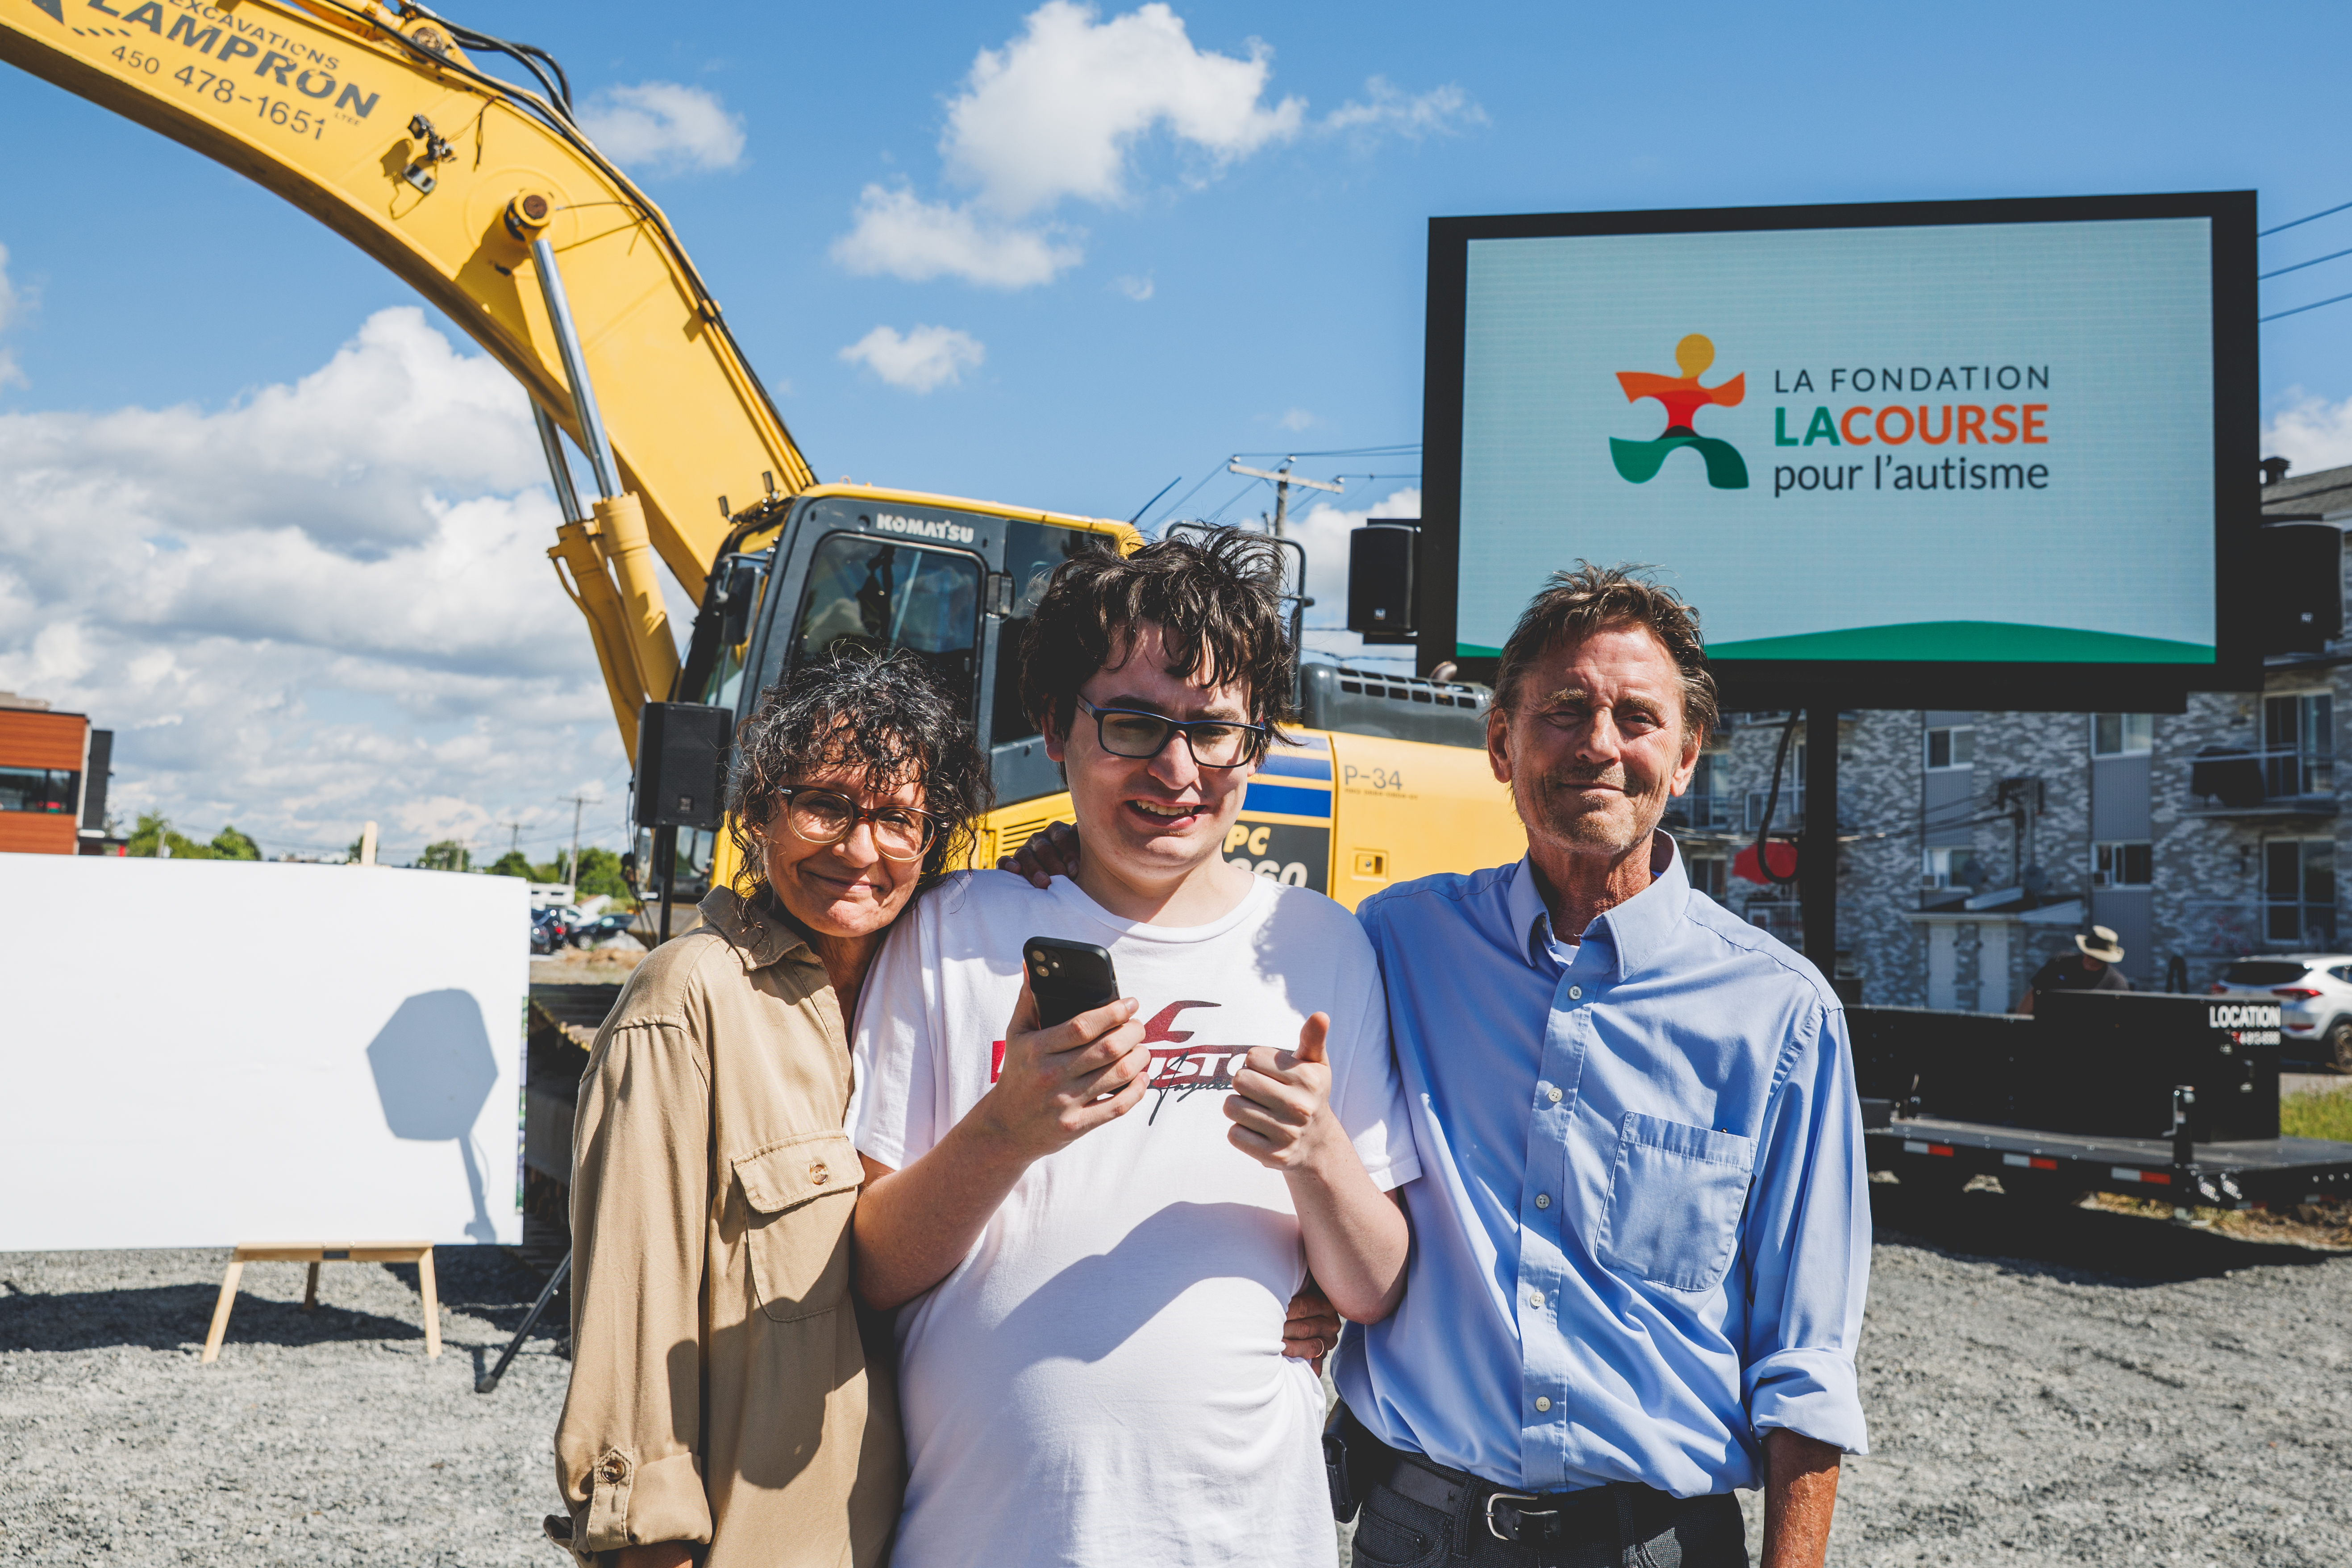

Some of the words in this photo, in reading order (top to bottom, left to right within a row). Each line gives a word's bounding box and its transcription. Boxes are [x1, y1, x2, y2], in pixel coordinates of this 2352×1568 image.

[112, 46, 160, 74] 450
[175, 66, 326, 140] 478-1651
[1775, 369, 1814, 393] LA
[1831, 365, 2049, 392] FONDATION
[1775, 404, 2048, 446] LACOURSE
[1775, 466, 1864, 498] pour
[876, 513, 974, 544] KOMATSU
[1345, 765, 1403, 790] P-34
[1223, 824, 1271, 856] PC
[1228, 857, 1308, 888] 60
[2209, 1006, 2281, 1028] LOCATION
